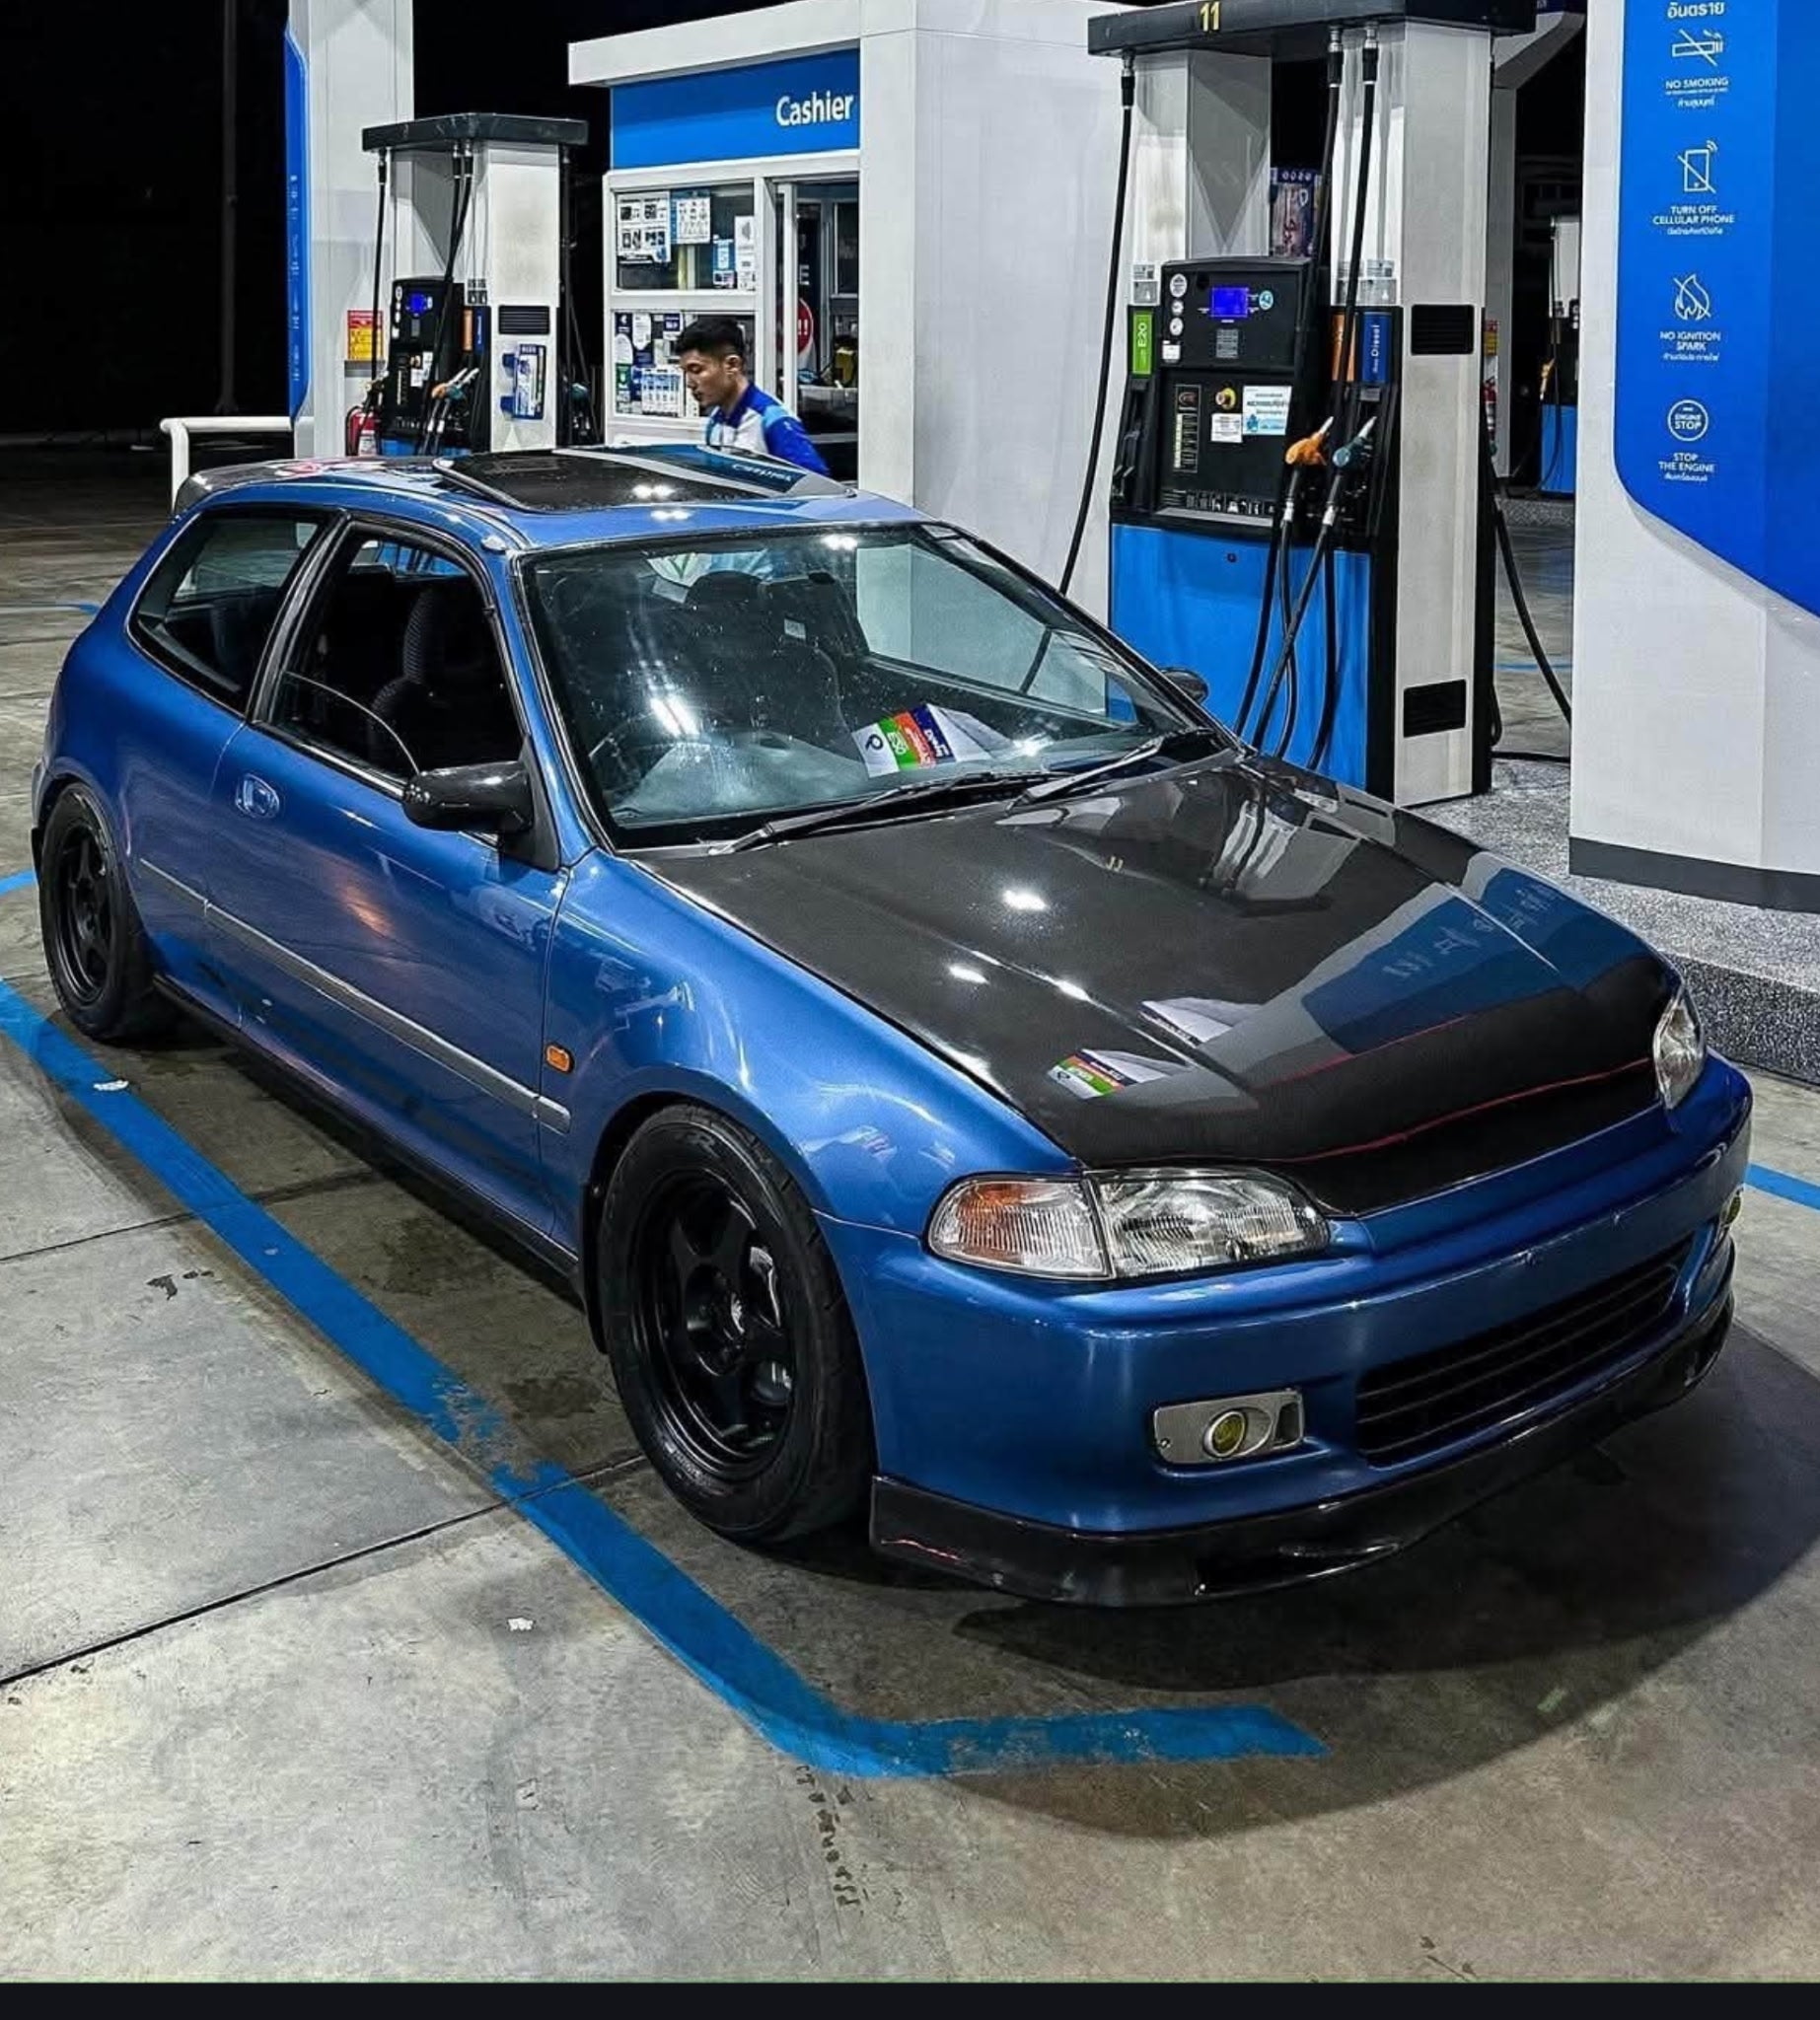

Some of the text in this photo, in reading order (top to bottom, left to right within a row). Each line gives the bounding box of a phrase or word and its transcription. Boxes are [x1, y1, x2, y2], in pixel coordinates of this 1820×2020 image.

[1201, 1, 1220, 32] 11
[1665, 77, 1729, 90] NO SMOKING
[775, 91, 854, 126] Cashier
[1670, 204, 1717, 215] TURN OFF
[1652, 214, 1735, 225] CELLULAR PHONE
[1137, 323, 1147, 348] E20
[1659, 330, 1721, 341] NO IGNITION
[1676, 341, 1707, 351] SPARK
[1675, 420, 1702, 430] STOP
[1673, 452, 1699, 462] STOP
[1658, 461, 1715, 473] THE ENGINE
